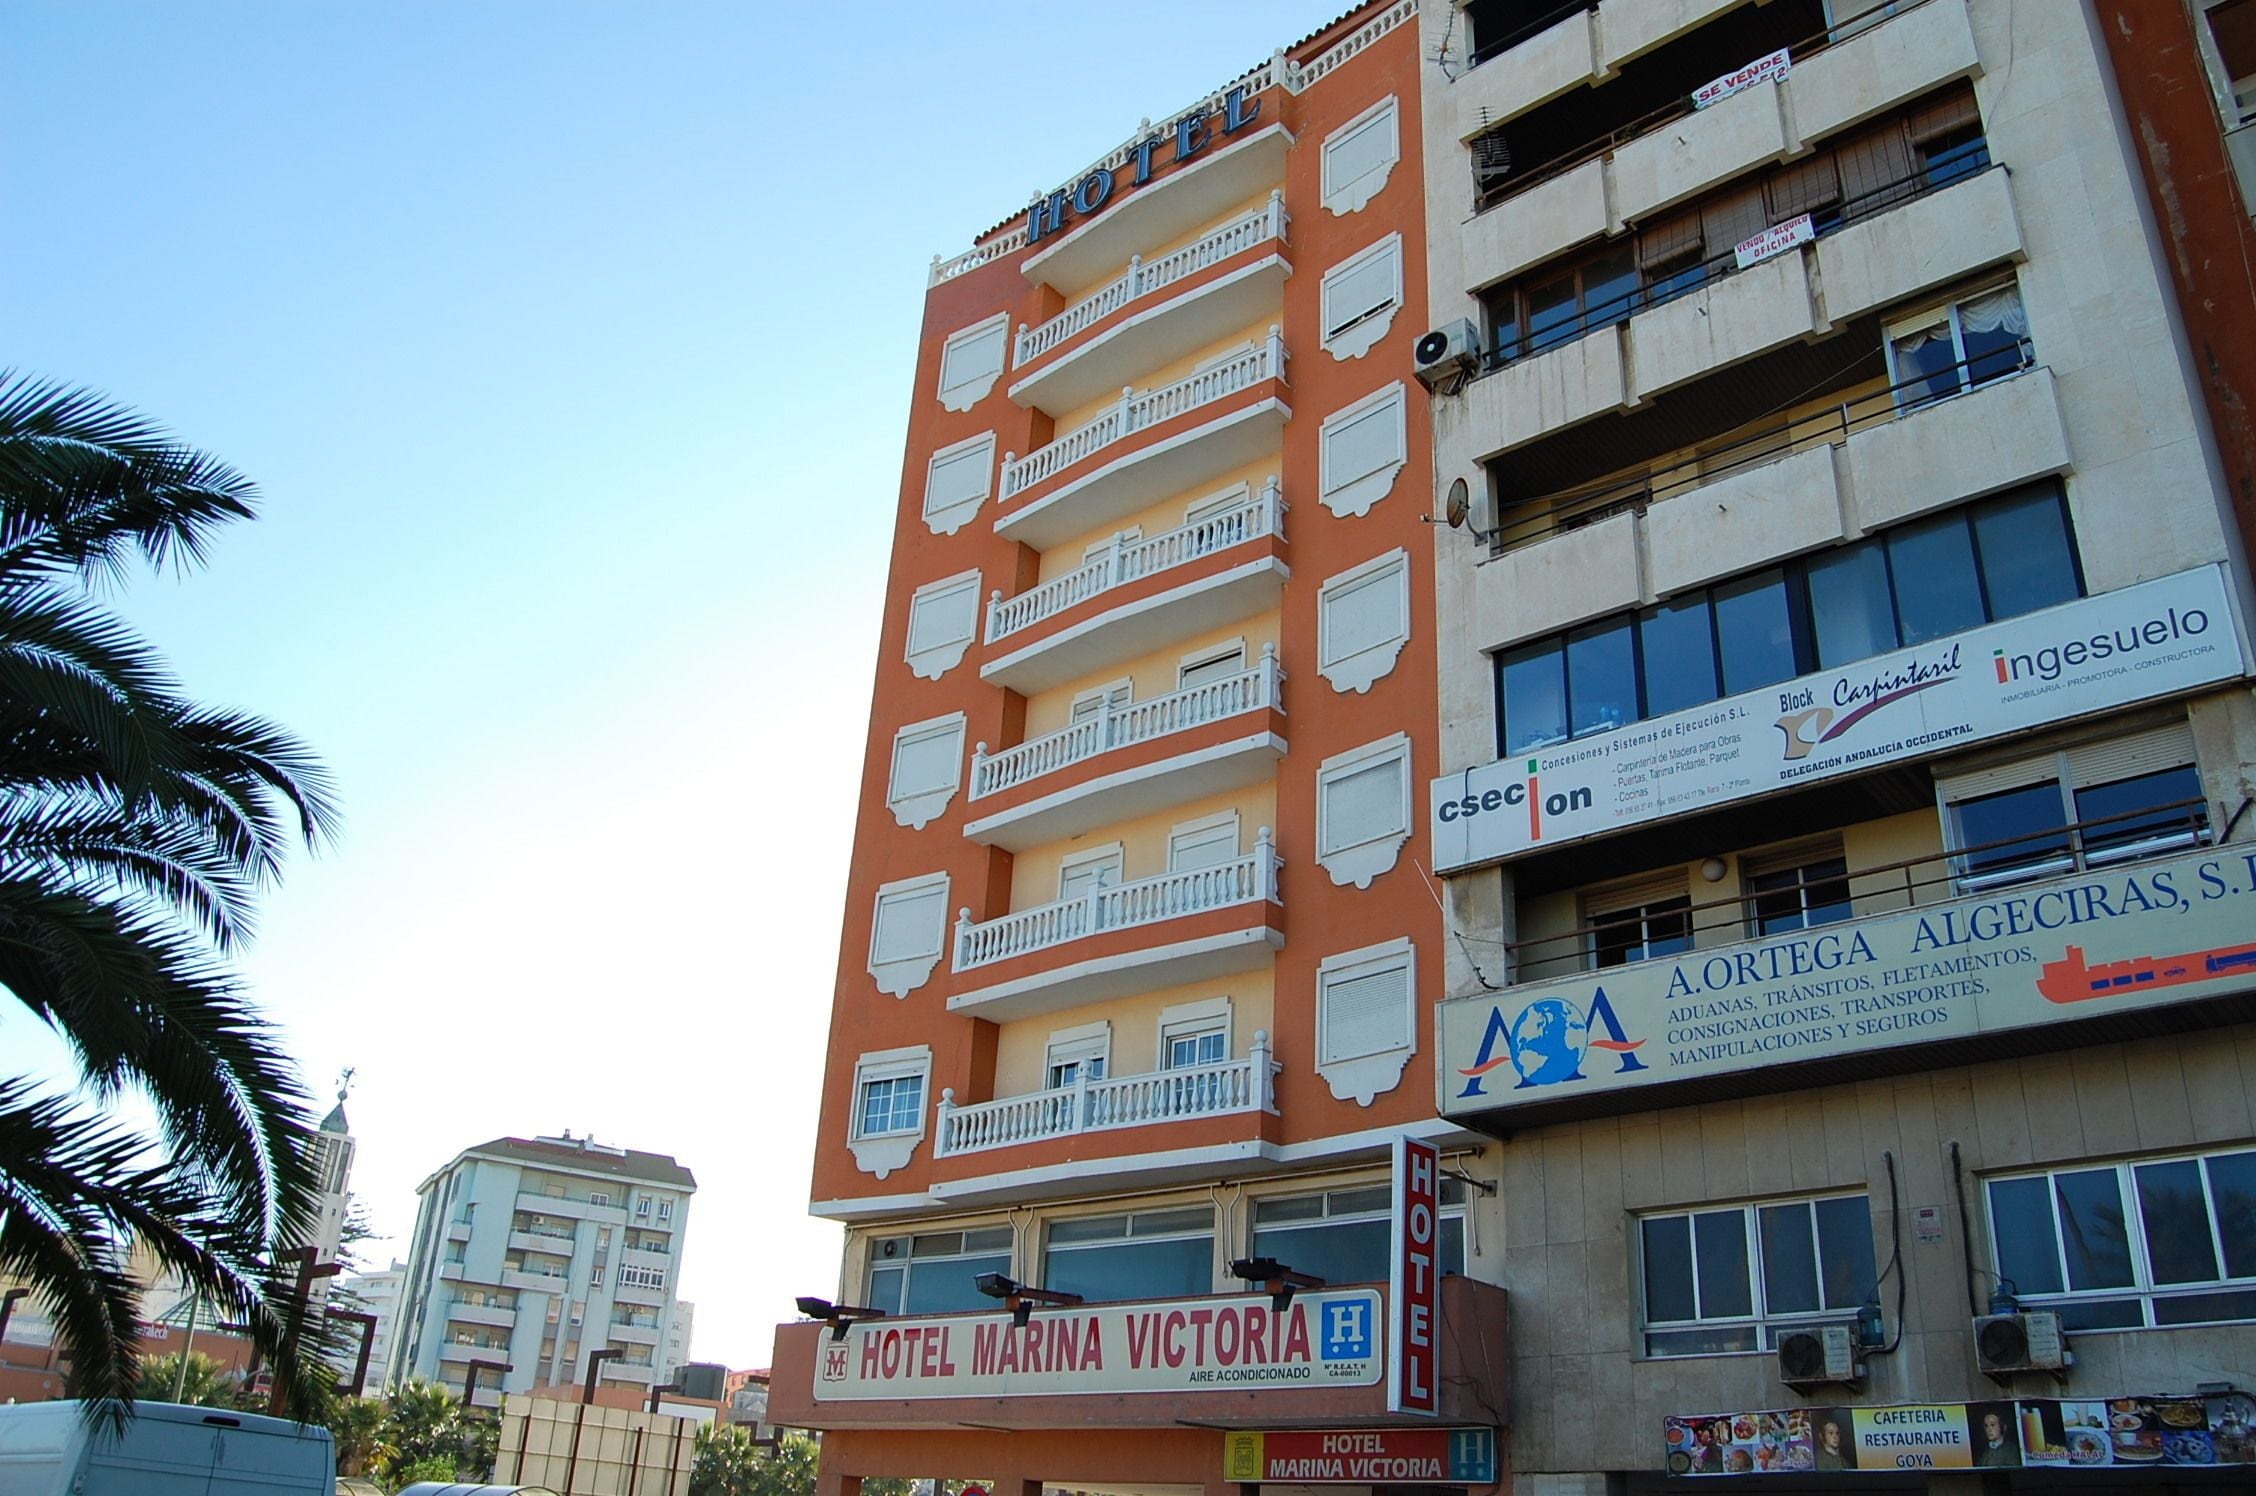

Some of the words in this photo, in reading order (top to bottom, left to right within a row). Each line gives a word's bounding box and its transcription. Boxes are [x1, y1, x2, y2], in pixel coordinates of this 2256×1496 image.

[1699, 84, 1721, 102] SE
[1724, 53, 1784, 88] VENDE
[1025, 85, 1261, 247] HOTEL
[1754, 232, 1796, 258] OFICINA
[1993, 607, 2209, 684] ingesuelo
[2001, 681, 2061, 704] INMOBILIARIA
[2067, 665, 2128, 689] PROMOTORA
[2134, 644, 2216, 671] CONSTRUCTORA
[1779, 687, 1815, 713] Block
[1541, 746, 1602, 771] Concesiones
[1604, 745, 1611, 757] y
[1613, 731, 1659, 752] Sistemas
[1661, 727, 1673, 739] de
[1675, 711, 1727, 736] Ejecución
[1729, 706, 1750, 720] S.L.
[1658, 751, 1669, 762] de
[1669, 745, 1698, 759] Madera
[1699, 740, 1716, 754] para
[1717, 733, 1742, 747] Obras
[1709, 747, 1740, 764] Parquet
[1779, 755, 1842, 781] DELEGACIÓN
[1845, 740, 1904, 764] ANDALUCÍA
[1906, 723, 1973, 749] OCCIDENTAL
[1619, 787, 1649, 802] Cocinas
[1665, 929, 1878, 999] A.ORTEGA
[1911, 872, 2190, 954] ALGECIRAS,
[1668, 997, 1758, 1025] ADUANAS,
[1763, 974, 1875, 1009] TRÁNSITOS,
[1882, 946, 2038, 987] FLETAMENTOS,
[1667, 1004, 1836, 1046] CONSIGNACIONES,
[1840, 978, 1991, 1017] TRANSPORTES,
[1669, 1026, 1833, 1067] MANIPULACIONES
[1837, 1021, 1850, 1039] Y
[1856, 1006, 1949, 1037] SEGUROS
[1410, 1153, 1432, 1400] HOTEL
[860, 1326, 955, 1380] HOTEL
[972, 1317, 1104, 1376] MARINA
[1126, 1303, 1312, 1370] VICTORIA
[1330, 1305, 1364, 1343] H
[1189, 1371, 1214, 1383] AIRE
[1216, 1367, 1311, 1382] ACONDICIONADO
[1865, 1430, 1961, 1447] RESTAURANTE
[1873, 1409, 1946, 1425] CAFETERIA
[1323, 1434, 1385, 1453] HOTEL
[1895, 1454, 1933, 1467] GOYA
[1270, 1457, 1345, 1478] MARINA
[1350, 1457, 1442, 1478] VICTORIA
